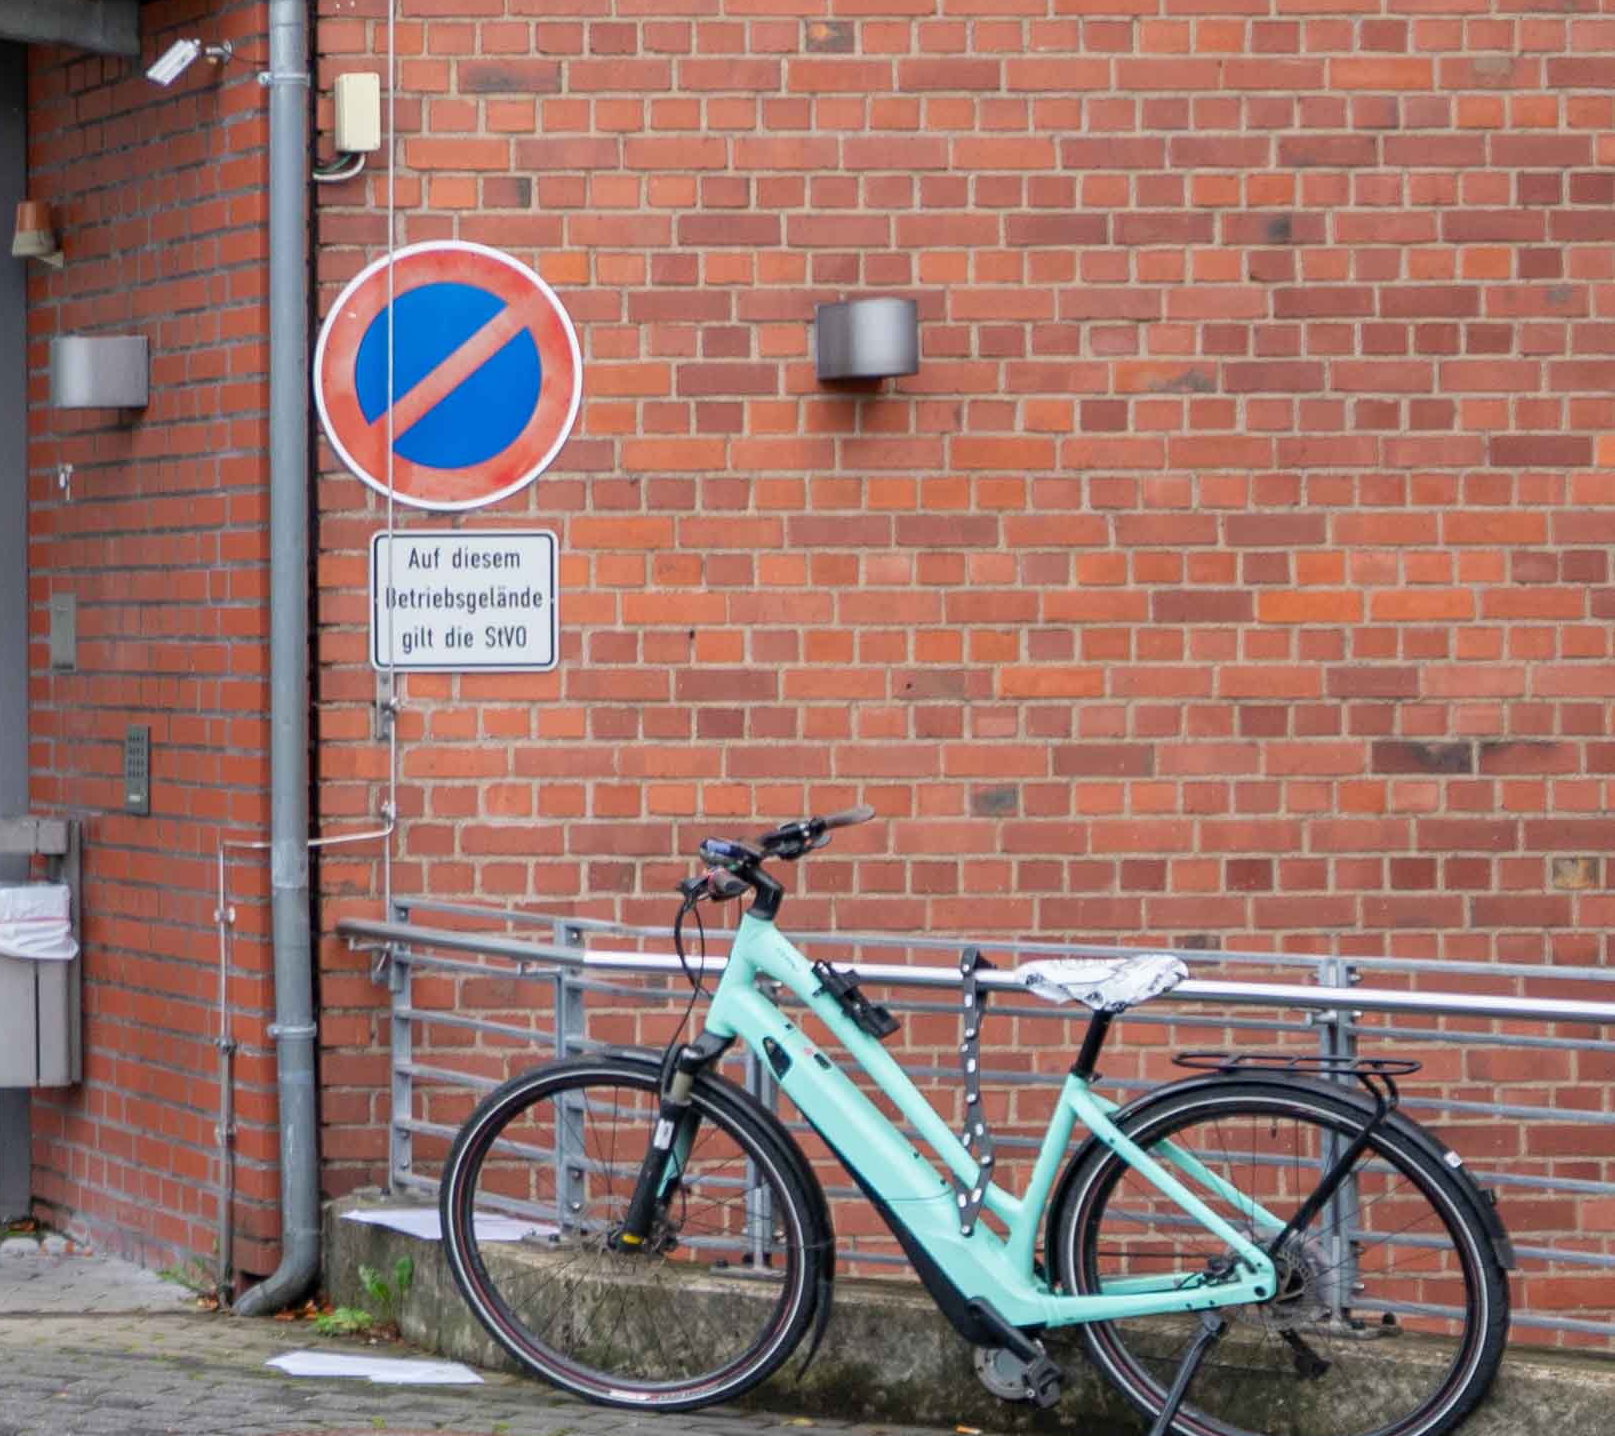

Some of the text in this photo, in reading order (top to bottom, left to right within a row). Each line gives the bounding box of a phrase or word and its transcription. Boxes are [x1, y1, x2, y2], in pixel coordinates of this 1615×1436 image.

[408, 547, 521, 570] Auf diesem
[401, 625, 527, 654] gilt die StVO
